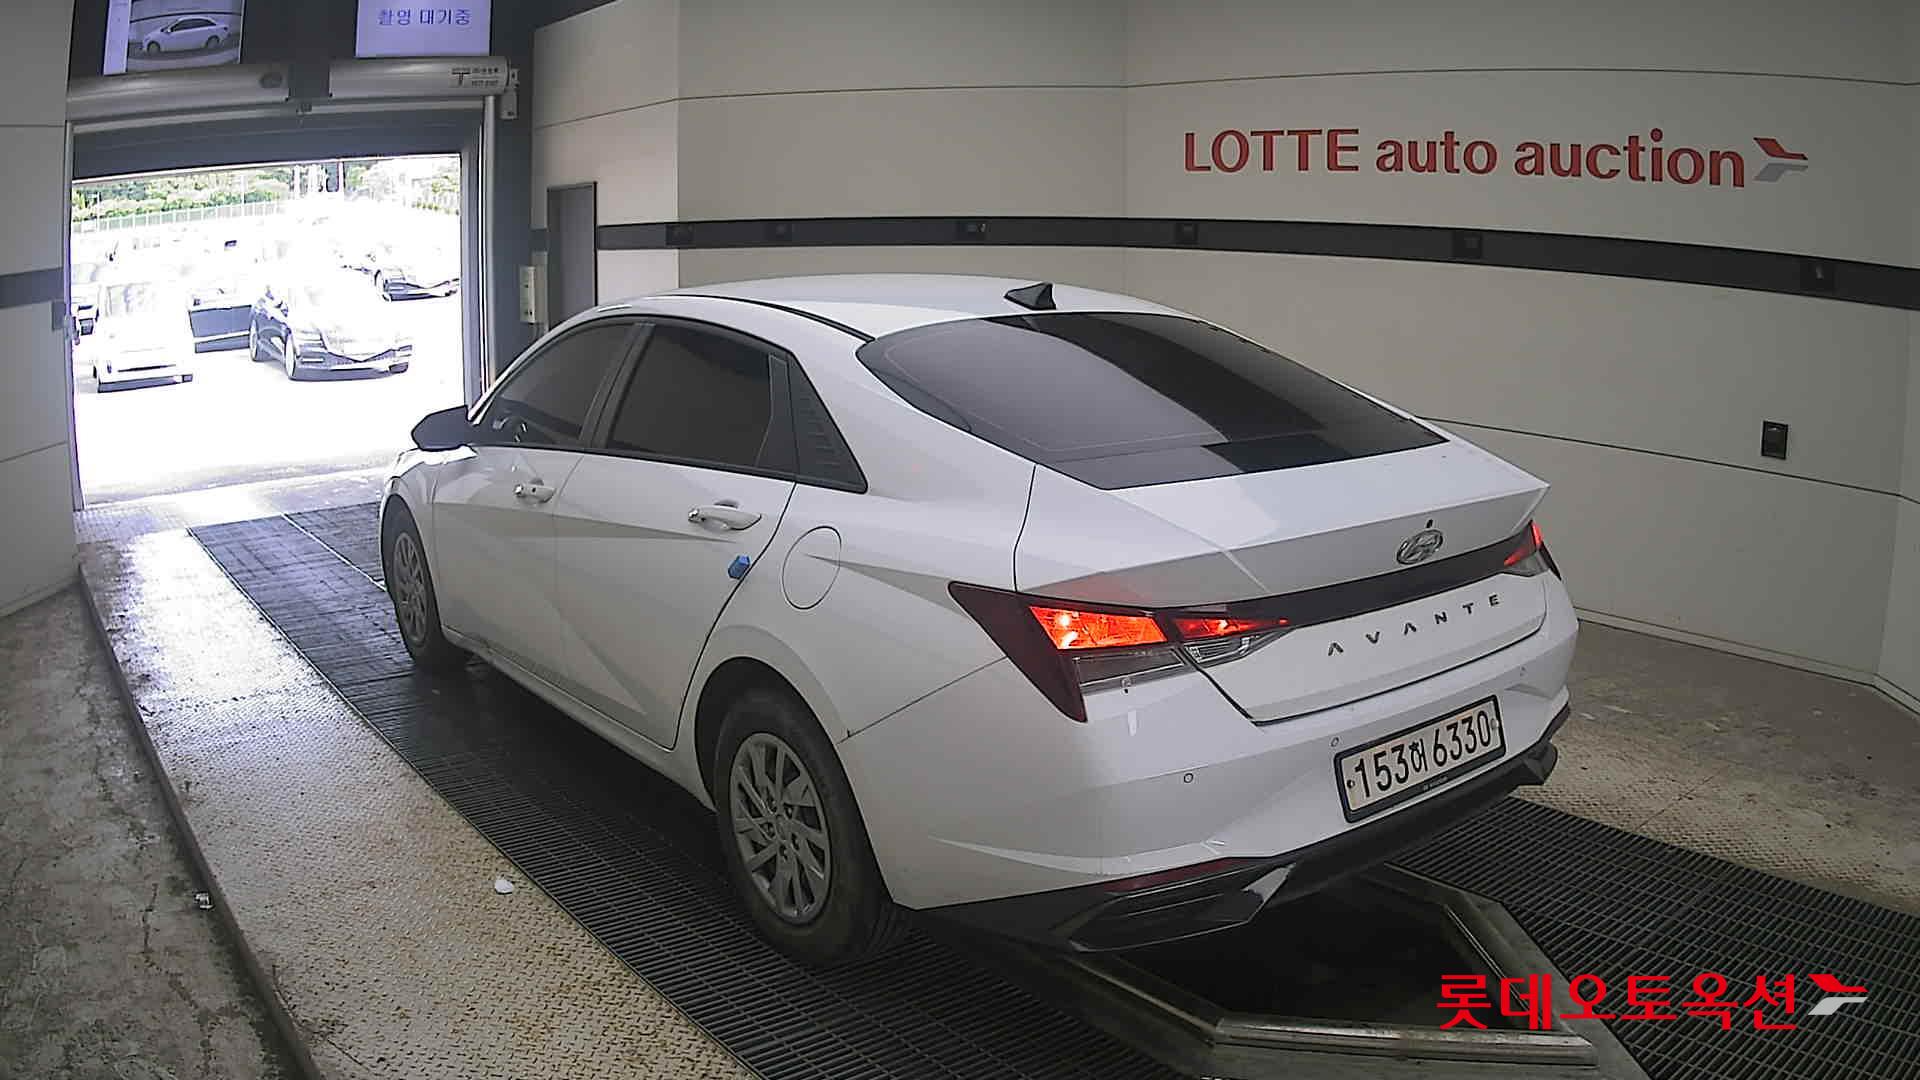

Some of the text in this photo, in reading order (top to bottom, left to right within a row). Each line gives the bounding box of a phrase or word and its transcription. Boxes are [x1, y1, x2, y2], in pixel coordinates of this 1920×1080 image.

[419, 8, 471, 26] 대기중
[1184, 128, 1745, 187] LOTTE auto auction
[1328, 594, 1500, 657] AVANTE
[1354, 710, 1491, 798] 153허 6330
